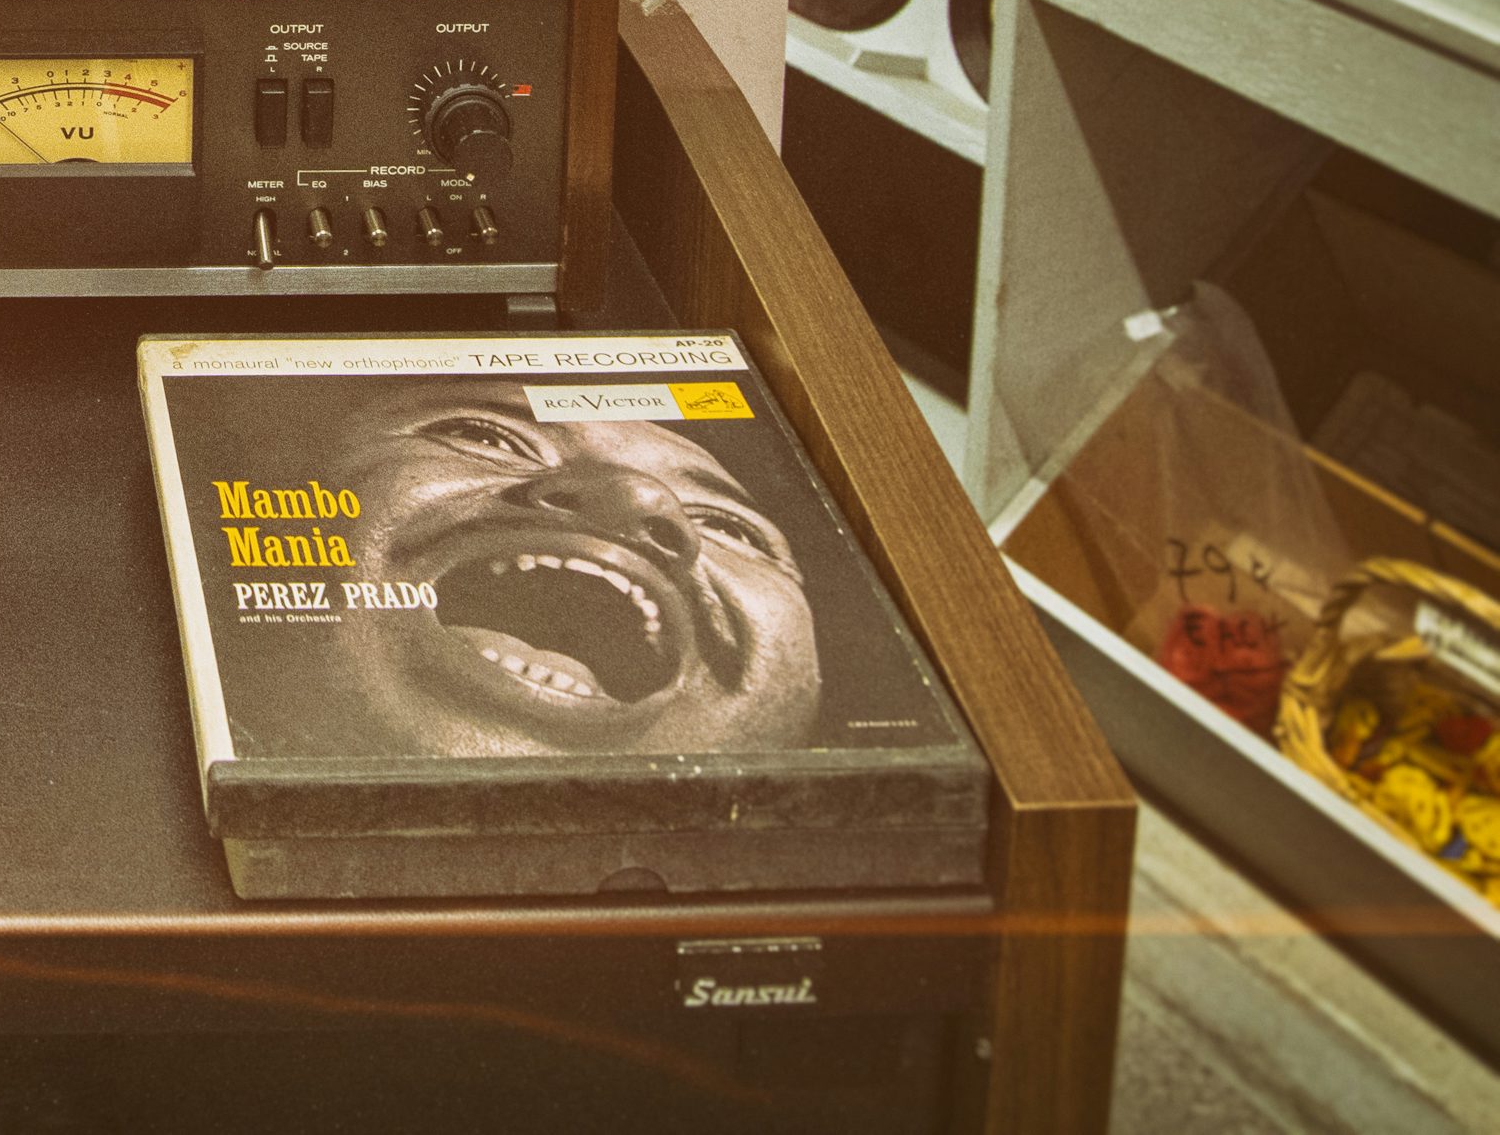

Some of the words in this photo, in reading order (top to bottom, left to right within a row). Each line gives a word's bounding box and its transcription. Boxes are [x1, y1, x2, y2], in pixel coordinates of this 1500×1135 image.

[270, 24, 324, 34] OUTPUT
[435, 23, 490, 33] OUTPUT
[283, 42, 329, 50] SOURCE
[301, 54, 328, 62] TAPE
[46, 70, 54, 78] 0
[104, 70, 112, 78] 3
[124, 73, 132, 81] 4
[103, 111, 129, 120] NORMAL
[60, 127, 94, 140] VU
[370, 166, 426, 175] RECORD
[247, 180, 284, 189] METER
[311, 180, 327, 189] EQ
[363, 179, 388, 188] BIAS
[172, 359, 184, 370] a
[194, 357, 279, 370] monaural
[343, 355, 460, 372] orthophonic"
[468, 353, 543, 367] TAPE
[555, 350, 733, 366] RECORDING
[211, 480, 361, 519] Mambo
[221, 527, 357, 567] Mania
[232, 582, 331, 610] PEREZ
[340, 582, 438, 610] PRADO
[239, 614, 261, 623] and
[265, 614, 283, 623] his
[286, 614, 342, 623] Orchestra
[684, 976, 817, 1008] Sansui
